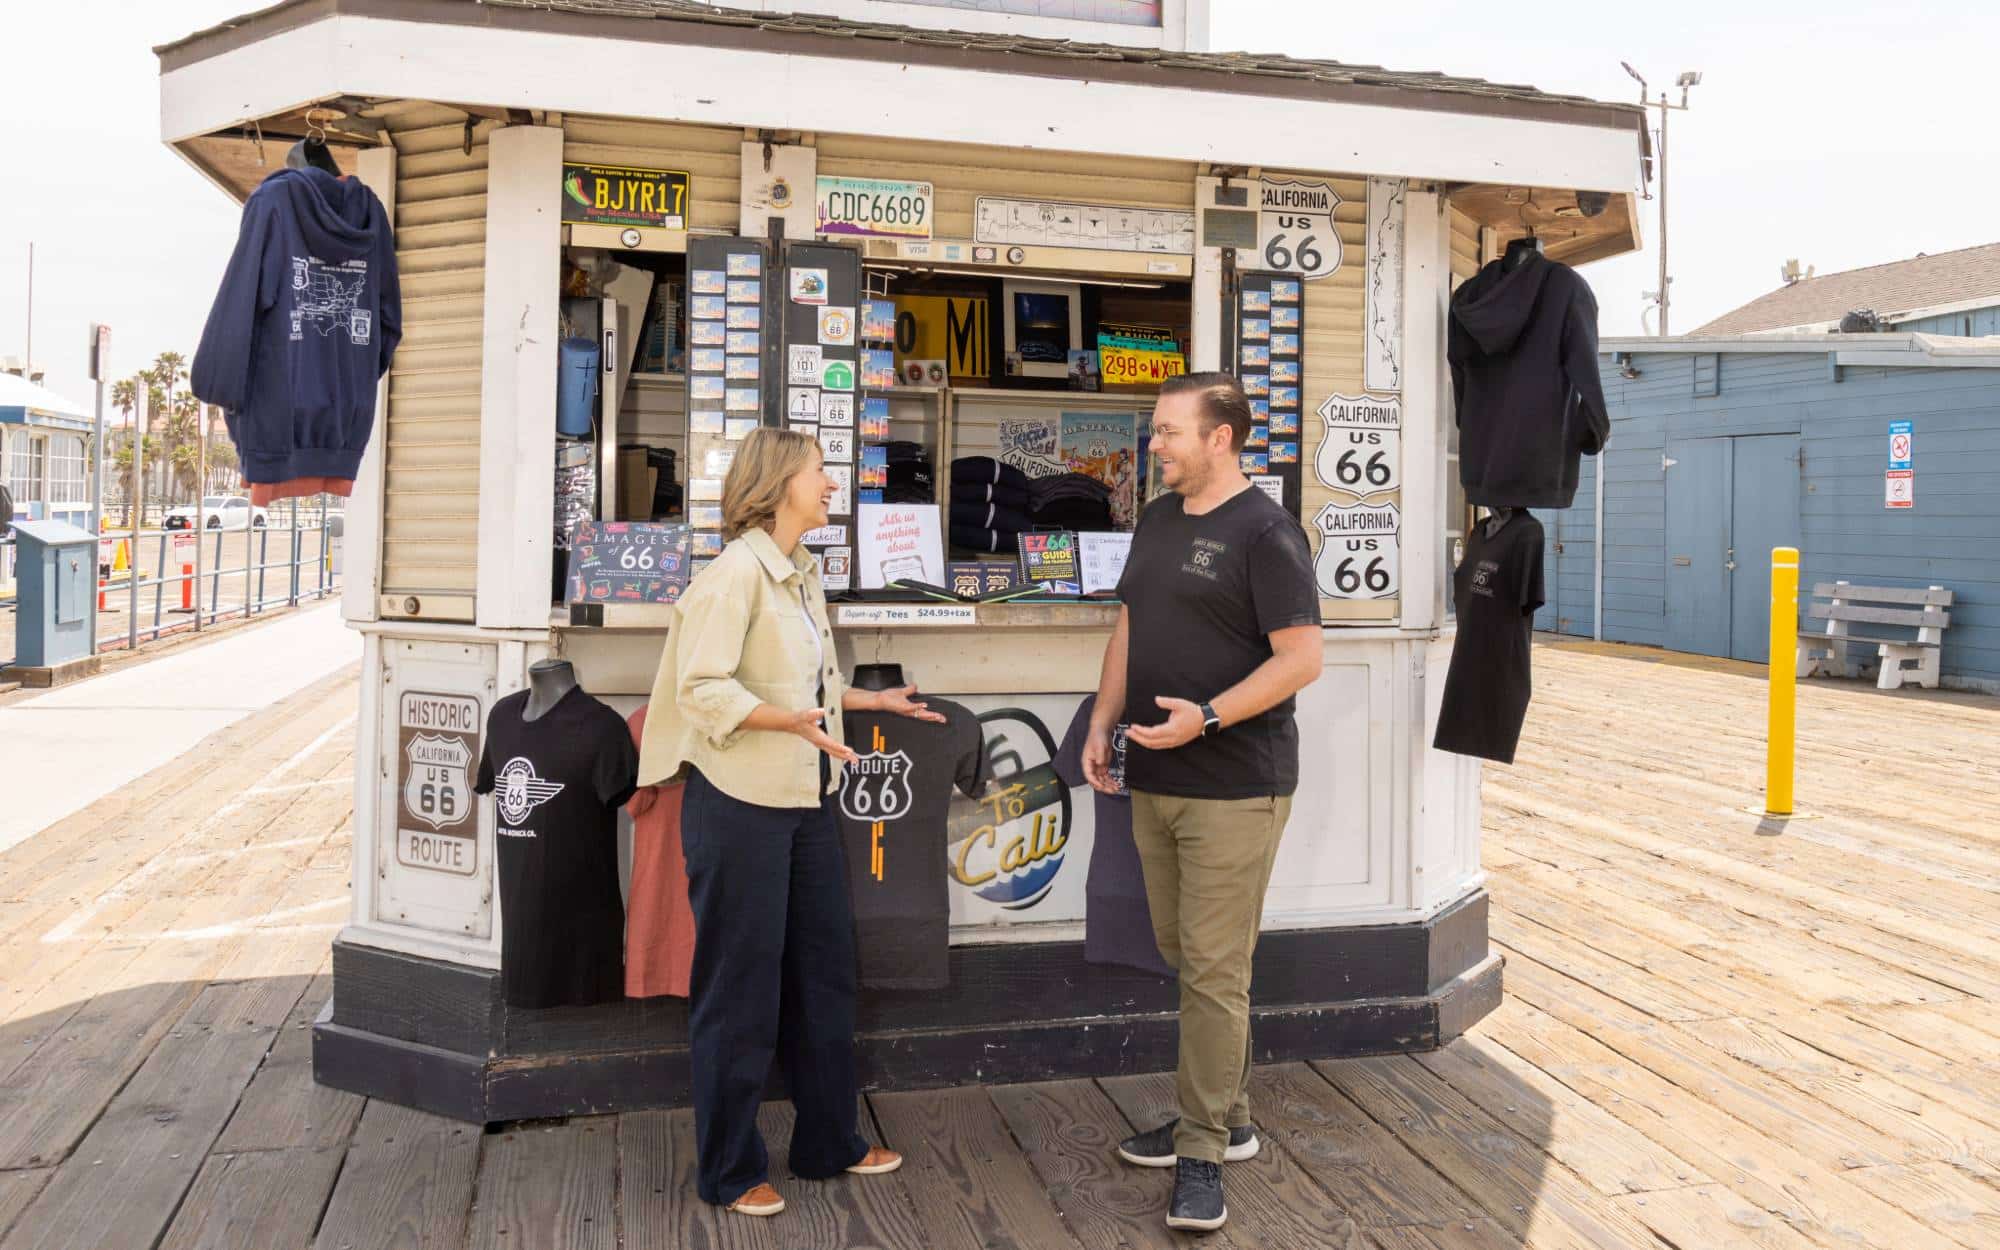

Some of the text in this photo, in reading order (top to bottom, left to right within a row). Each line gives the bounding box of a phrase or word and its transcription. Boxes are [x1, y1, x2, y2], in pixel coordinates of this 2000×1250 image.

[595, 178, 685, 215] BJYR17
[829, 192, 925, 225] CDC6689
[1278, 215, 1311, 230] US
[1265, 233, 1322, 271] 66
[797, 361, 813, 371] 101
[1105, 355, 1137, 377] 298
[829, 409, 845, 420] 66
[1330, 404, 1398, 424] CALIFORNIA
[829, 440, 843, 453] 66
[1349, 432, 1381, 445] US
[1091, 448, 1105, 457] 66
[1336, 449, 1391, 486] 66
[1326, 512, 1394, 530] CALIFORNIA
[594, 534, 670, 545] IMAGES
[875, 527, 921, 542] anything
[1025, 534, 1070, 553] EZ66
[887, 540, 916, 553] about
[1346, 538, 1378, 551] US
[608, 546, 619, 556] of
[620, 545, 654, 570] 66
[1042, 551, 1072, 560] GUIDE
[1194, 551, 1212, 567] 66
[1334, 556, 1389, 593] 66
[886, 610, 909, 619] Tees
[917, 607, 971, 617] $24.99+tax
[408, 700, 472, 729] HISTORIC
[416, 745, 461, 763] CALIFORNIA
[427, 767, 449, 782] US
[850, 759, 901, 775] ROUTE
[420, 783, 455, 816] 66
[508, 788, 523, 806] 66
[854, 776, 898, 814] 66
[980, 790, 1025, 826] To
[410, 836, 463, 866] ROUTE
[959, 812, 1066, 888] Cali
